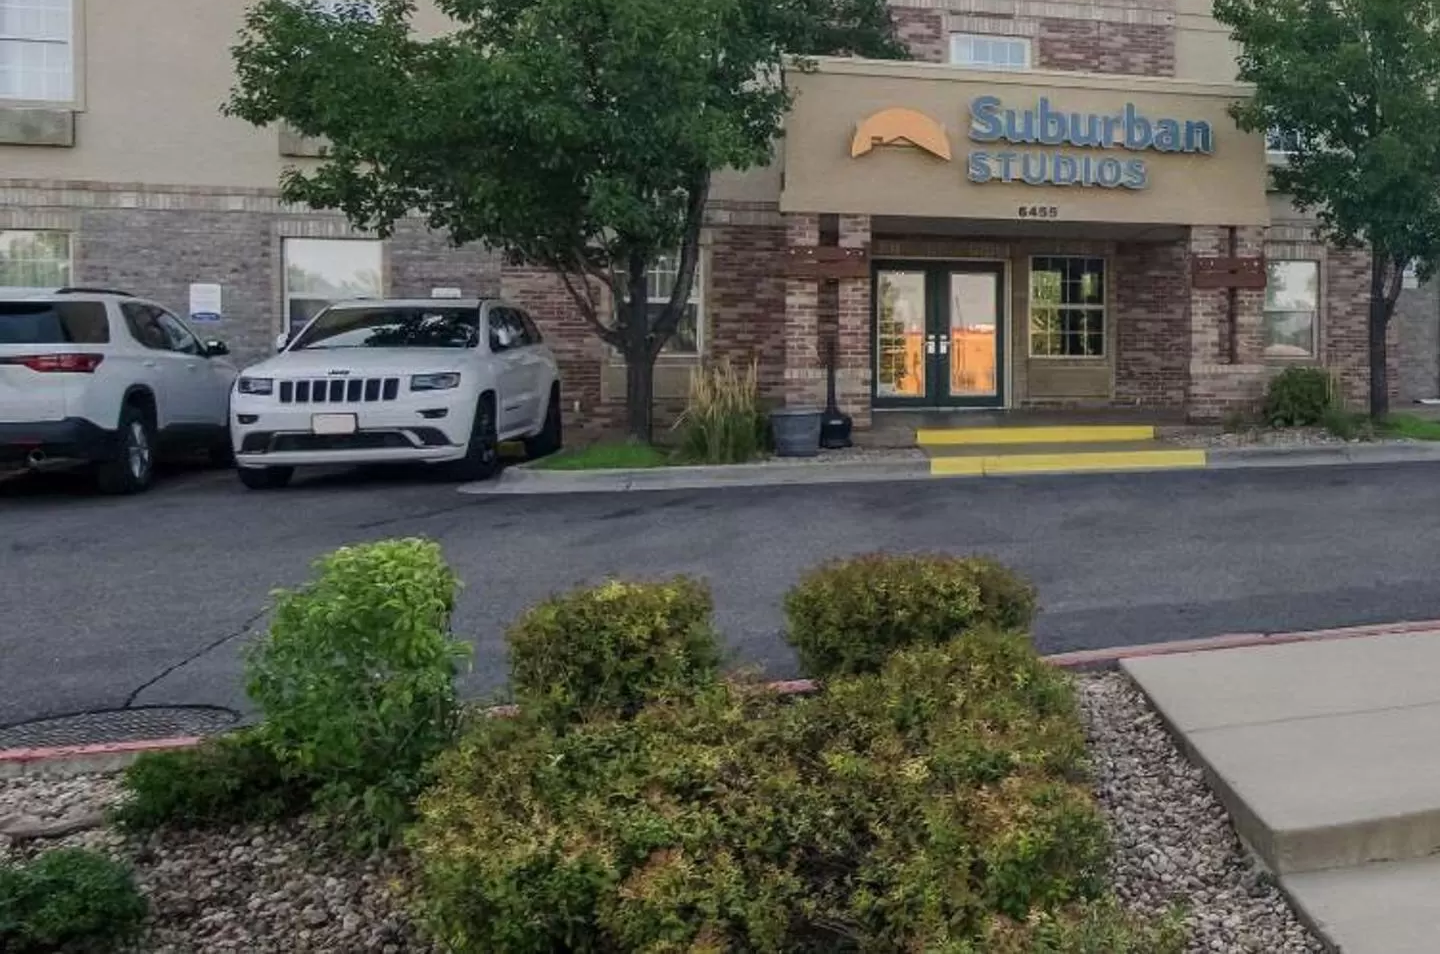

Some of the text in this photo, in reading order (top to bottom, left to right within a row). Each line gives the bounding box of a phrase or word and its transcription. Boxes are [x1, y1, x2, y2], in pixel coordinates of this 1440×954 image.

[968, 95, 1215, 155] Suburban
[967, 150, 1148, 189] STUDIOS
[1018, 206, 1058, 217] 6455
